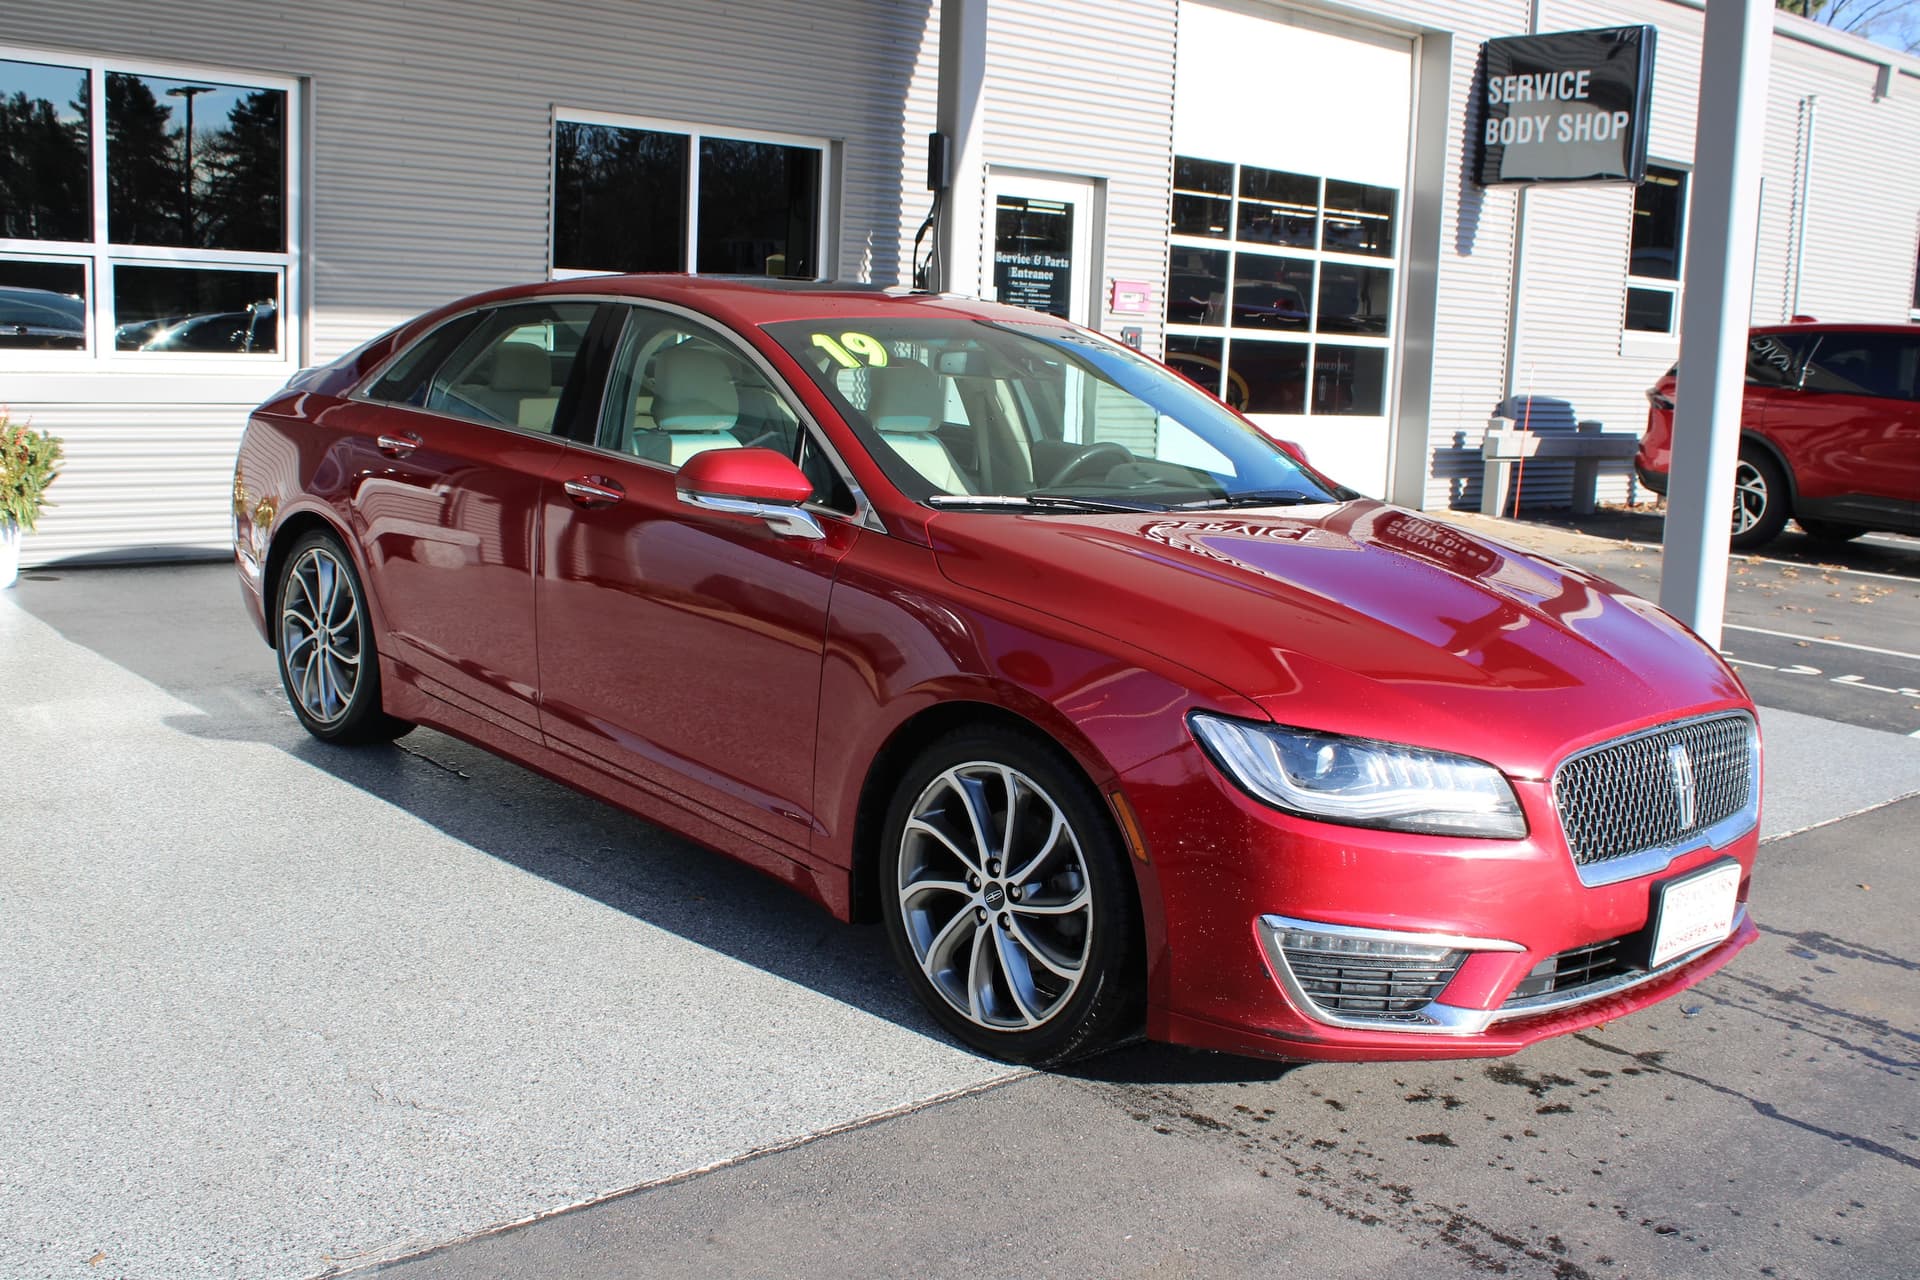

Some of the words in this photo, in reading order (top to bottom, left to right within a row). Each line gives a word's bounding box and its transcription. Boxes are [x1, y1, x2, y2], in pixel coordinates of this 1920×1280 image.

[1488, 70, 1591, 104] SERVICE
[1485, 115, 1550, 145] BODY
[1557, 111, 1630, 142] SHOP
[996, 251, 1031, 265] Service
[1034, 254, 1042, 266] &
[1044, 256, 1069, 268] Parts
[1011, 266, 1054, 280] Entrance
[811, 332, 888, 367] 19
